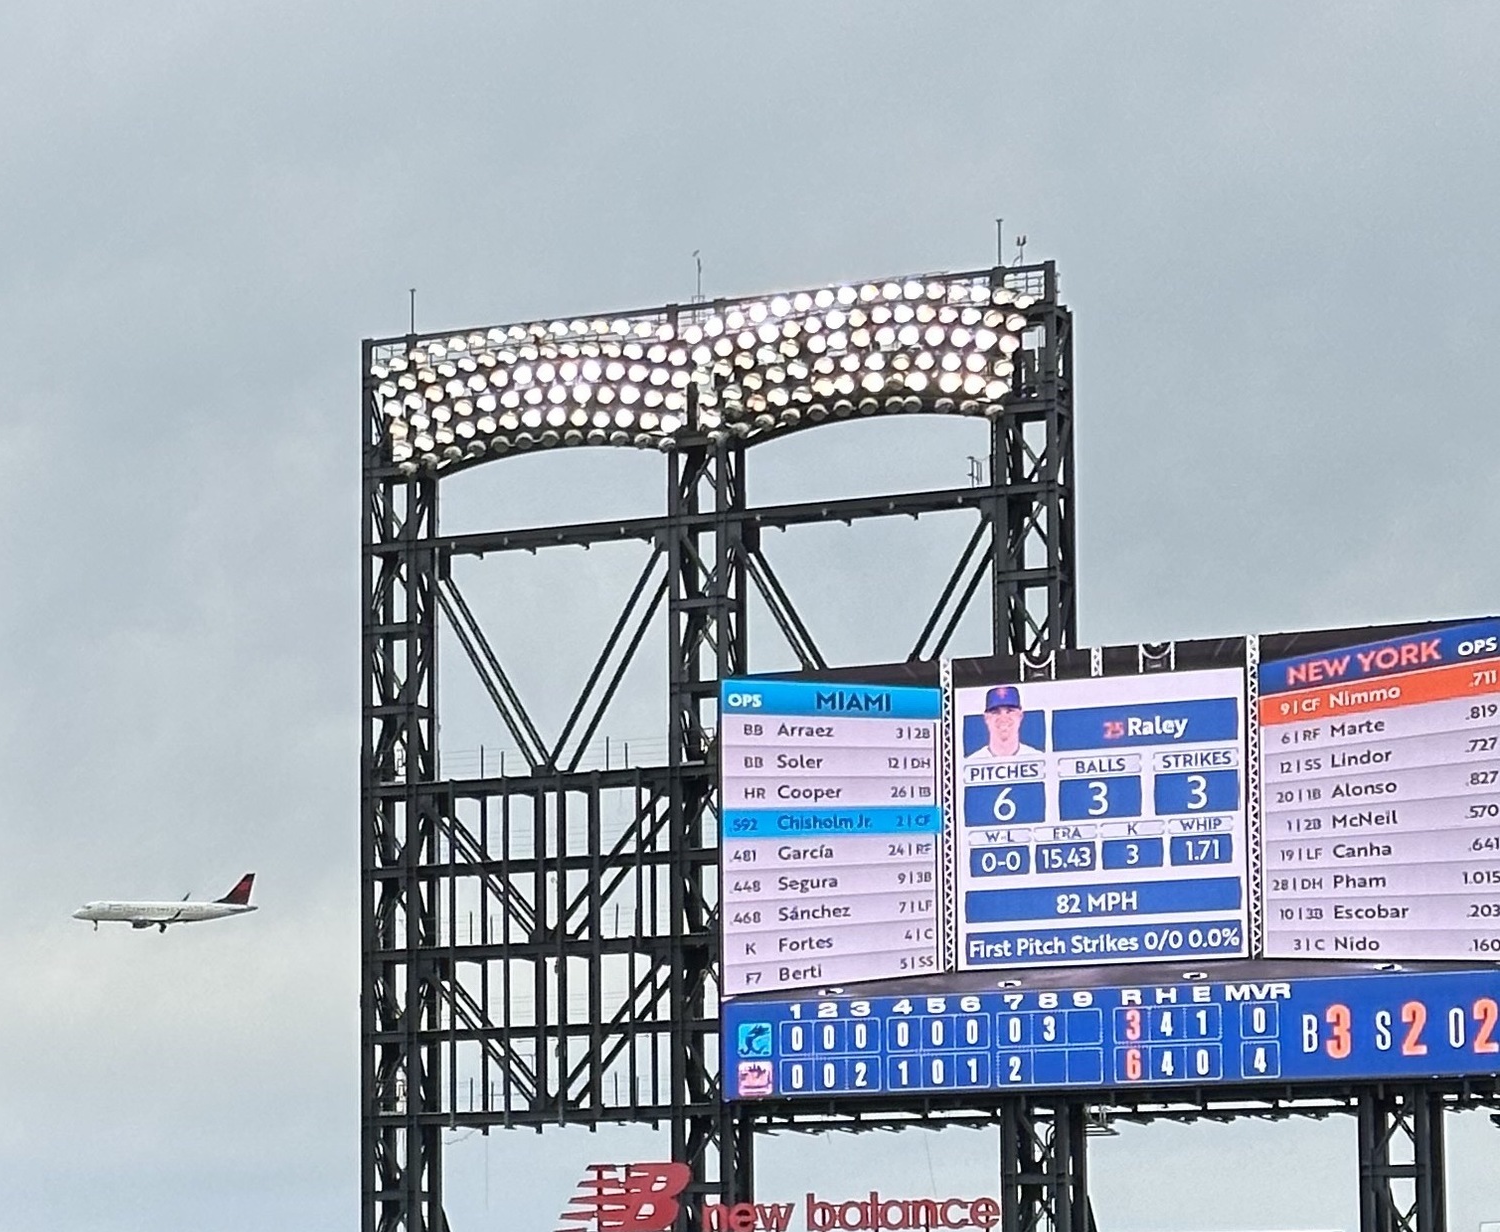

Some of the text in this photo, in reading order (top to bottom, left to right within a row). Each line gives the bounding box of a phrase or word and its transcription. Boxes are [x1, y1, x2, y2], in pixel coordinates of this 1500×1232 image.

[1287, 636, 1498, 685] NEW YORK OPS
[727, 691, 891, 712] OPS MIAMI
[1329, 686, 1401, 708] Nimmo
[1127, 717, 1188, 740] Raley
[1330, 704, 1498, 738] Marte .819
[777, 723, 834, 738] Arraez
[1162, 750, 1232, 769] STRIKES
[1331, 737, 1497, 768] Lindor .727
[777, 755, 823, 769] Soler
[1075, 758, 1125, 774] BALLS
[970, 763, 1039, 781] PITCHES
[777, 785, 842, 802] Cooper
[1088, 781, 1108, 816] 3
[1186, 775, 1208, 810] 3
[1331, 781, 1397, 798] Alonso
[993, 787, 1016, 821] 6
[777, 814, 851, 830] Chisholm
[856, 815, 873, 830] Jr.
[1180, 819, 1222, 832] WHIP
[1332, 804, 1499, 829] McNeil .570
[1053, 826, 1082, 840] ERA
[1127, 822, 1138, 835] K
[778, 845, 834, 861] García
[1043, 847, 1091, 869] 15.43
[1126, 844, 1139, 865] 3
[1186, 839, 1219, 861] 1.71
[1333, 842, 1392, 858] Canha
[981, 851, 1021, 870] 0-0
[778, 876, 838, 893] Segura
[1333, 875, 1386, 889] Pham
[1056, 891, 1138, 914] 82 MPH
[778, 905, 851, 922] Sánchez
[1334, 904, 1409, 920] Escobar
[779, 935, 833, 953] Fortes
[970, 927, 1240, 959] First Pitch Strikes 0/0 0.0%
[1334, 937, 1380, 951] Nido
[779, 964, 822, 981] Berti
[806, 1191, 1000, 1232] balance
